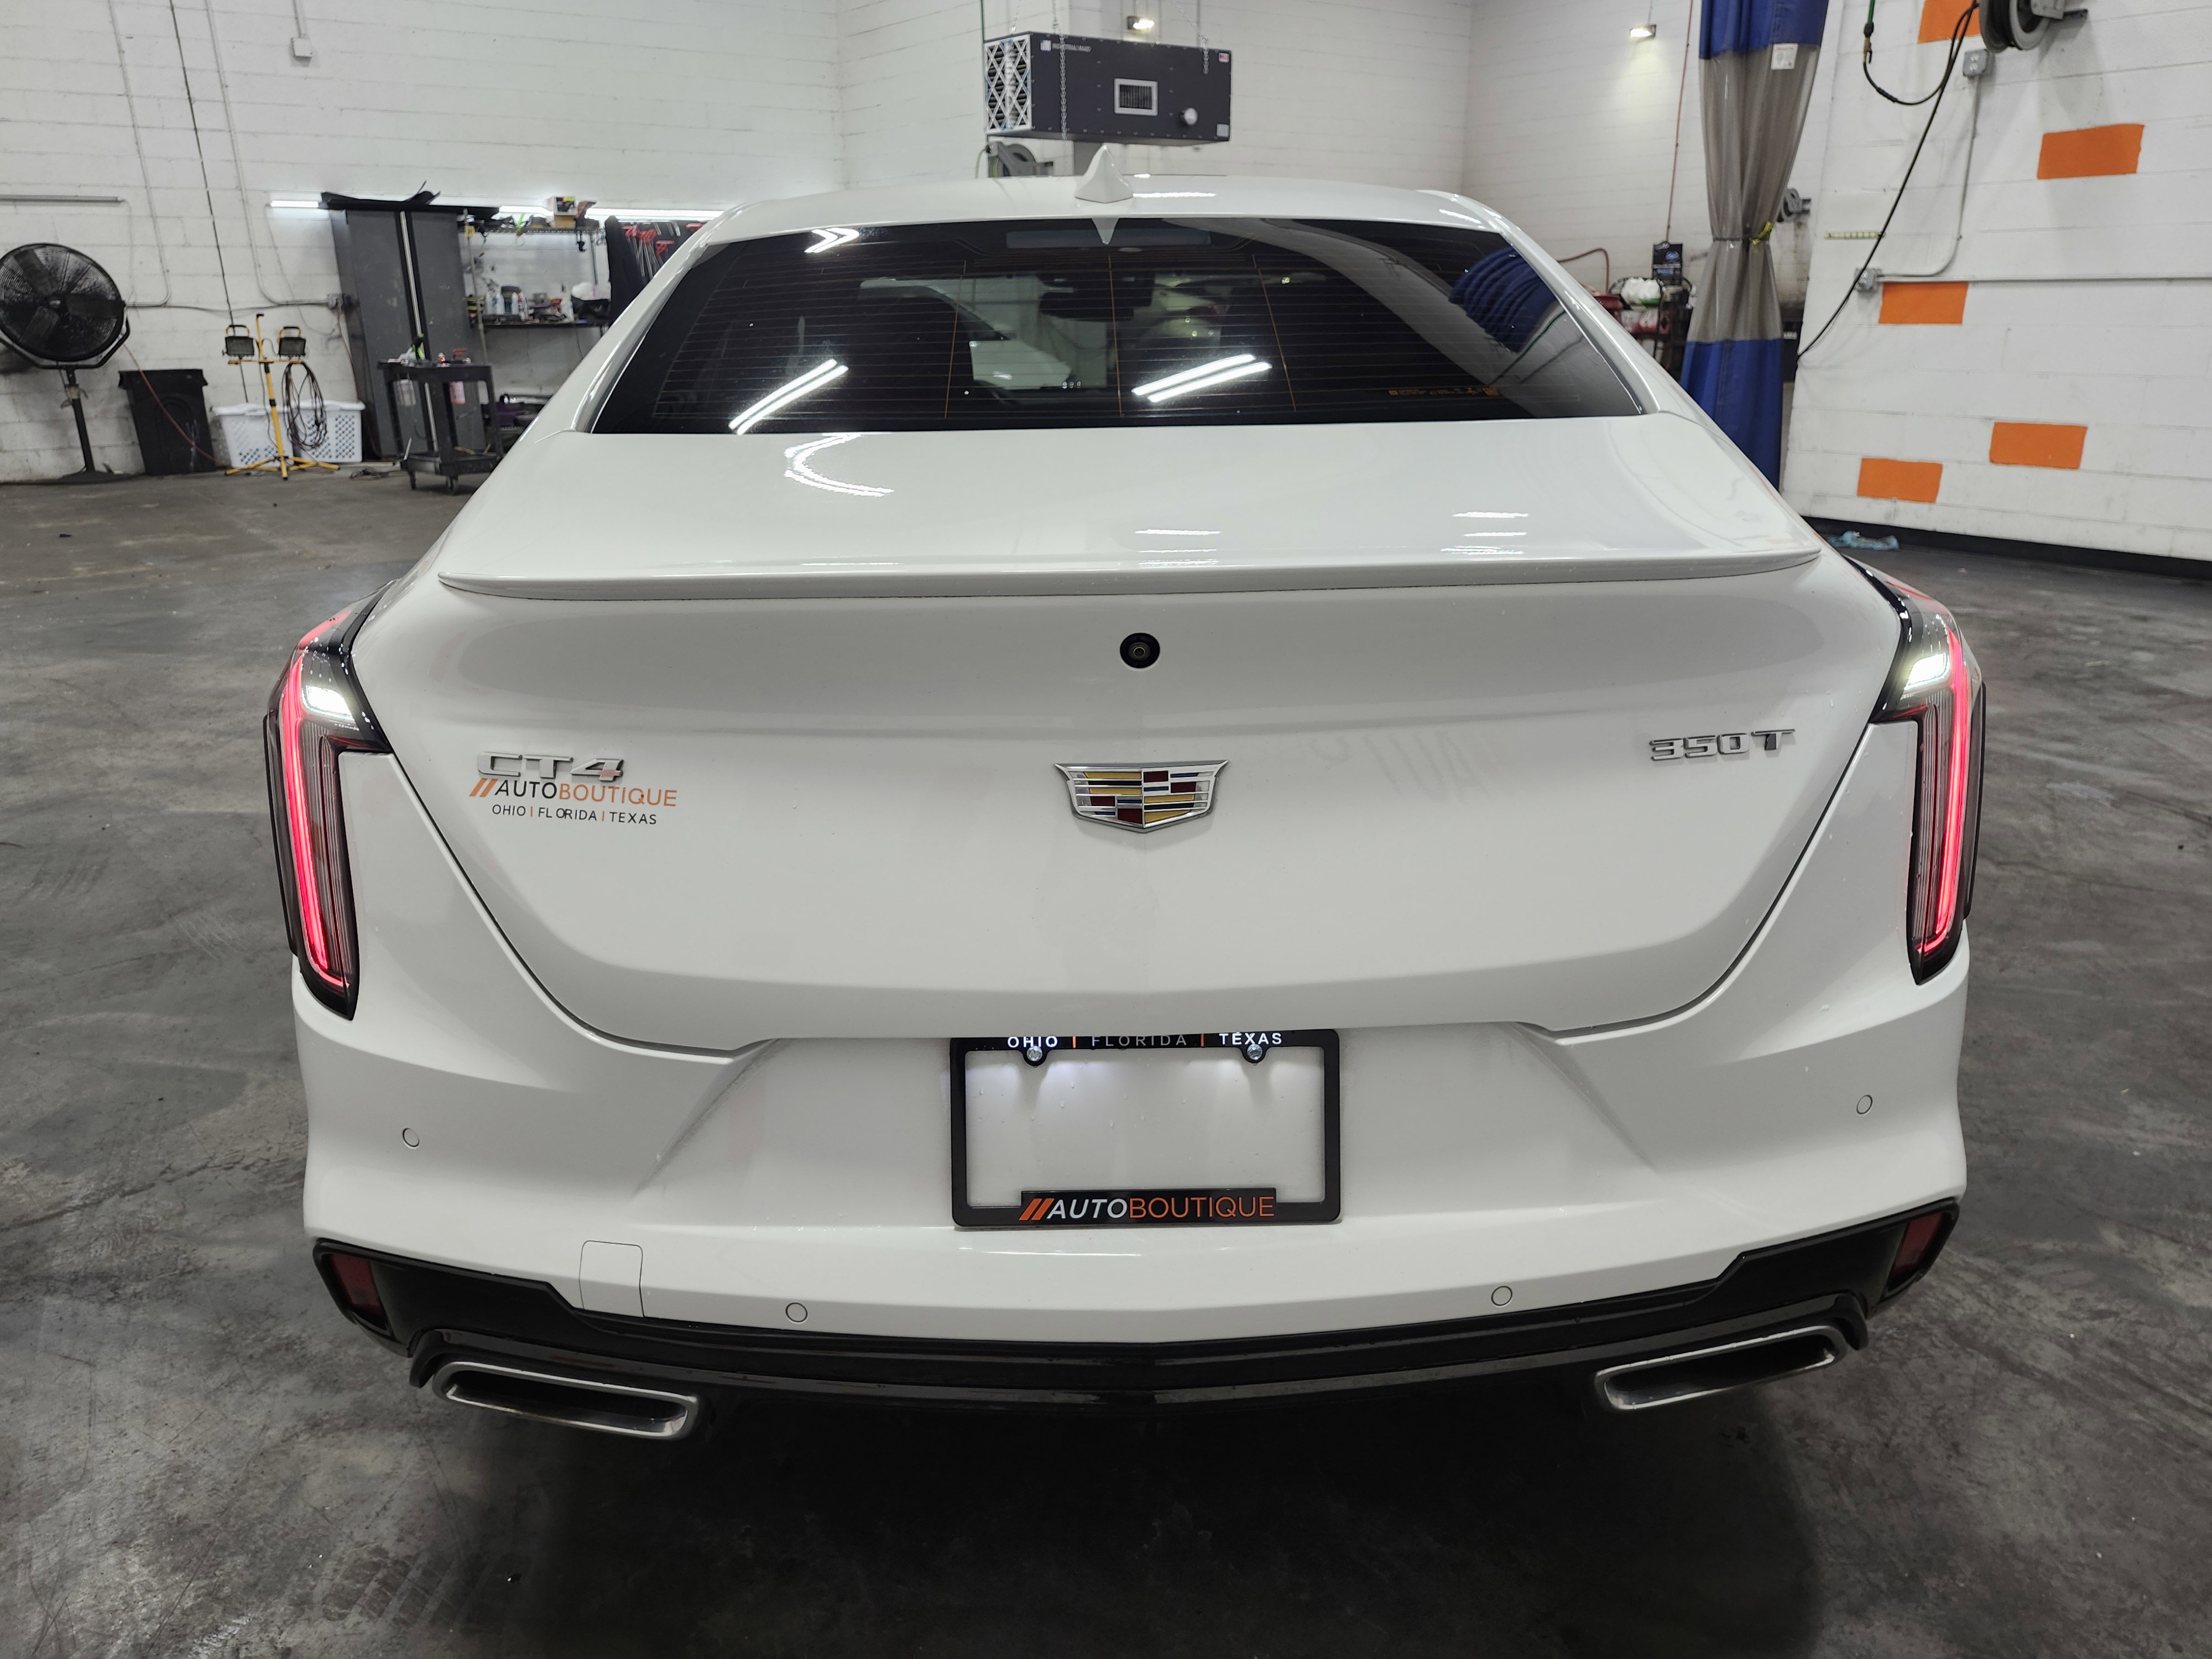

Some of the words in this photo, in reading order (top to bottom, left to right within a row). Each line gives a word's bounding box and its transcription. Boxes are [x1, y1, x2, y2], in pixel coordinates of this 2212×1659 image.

[477, 751, 624, 782] CT4
[495, 779, 677, 807] AUTOBOUTIQUE
[492, 804, 526, 817] OHIO
[538, 807, 597, 822] FLORIDA
[609, 811, 657, 825] TEXAS
[1007, 1035, 1058, 1048] OHIO
[1092, 1034, 1187, 1047] FLORIDA
[1218, 1031, 1282, 1045] TEXAS
[1046, 1196, 1275, 1219] AUTOBOUTIQUE
